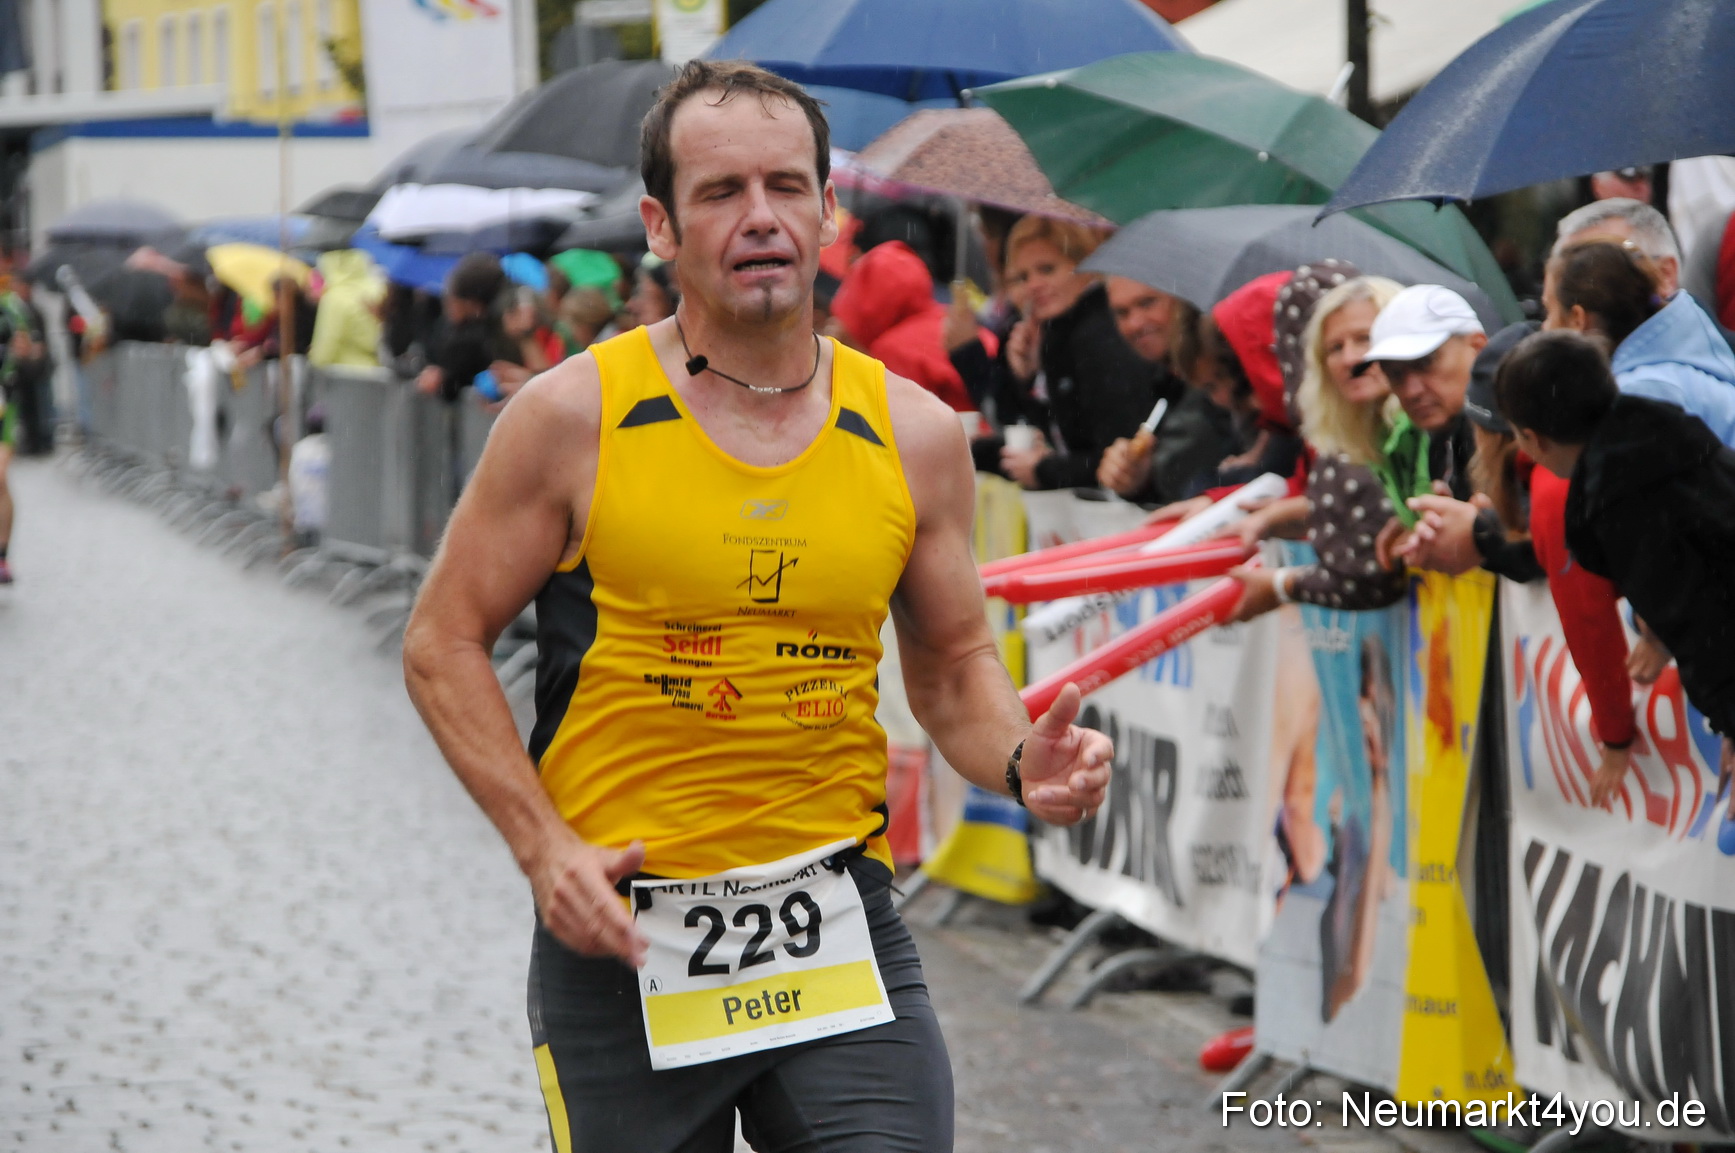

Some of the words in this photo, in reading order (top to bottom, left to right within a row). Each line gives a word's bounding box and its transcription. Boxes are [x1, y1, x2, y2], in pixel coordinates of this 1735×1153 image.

[664, 621, 722, 633] Schreinerei
[662, 633, 722, 656] Seidl
[670, 655, 713, 668] Herngau
[797, 698, 844, 718] ELIO
[684, 891, 823, 978] 229
[649, 978, 658, 992] A
[722, 988, 802, 1026] Peter
